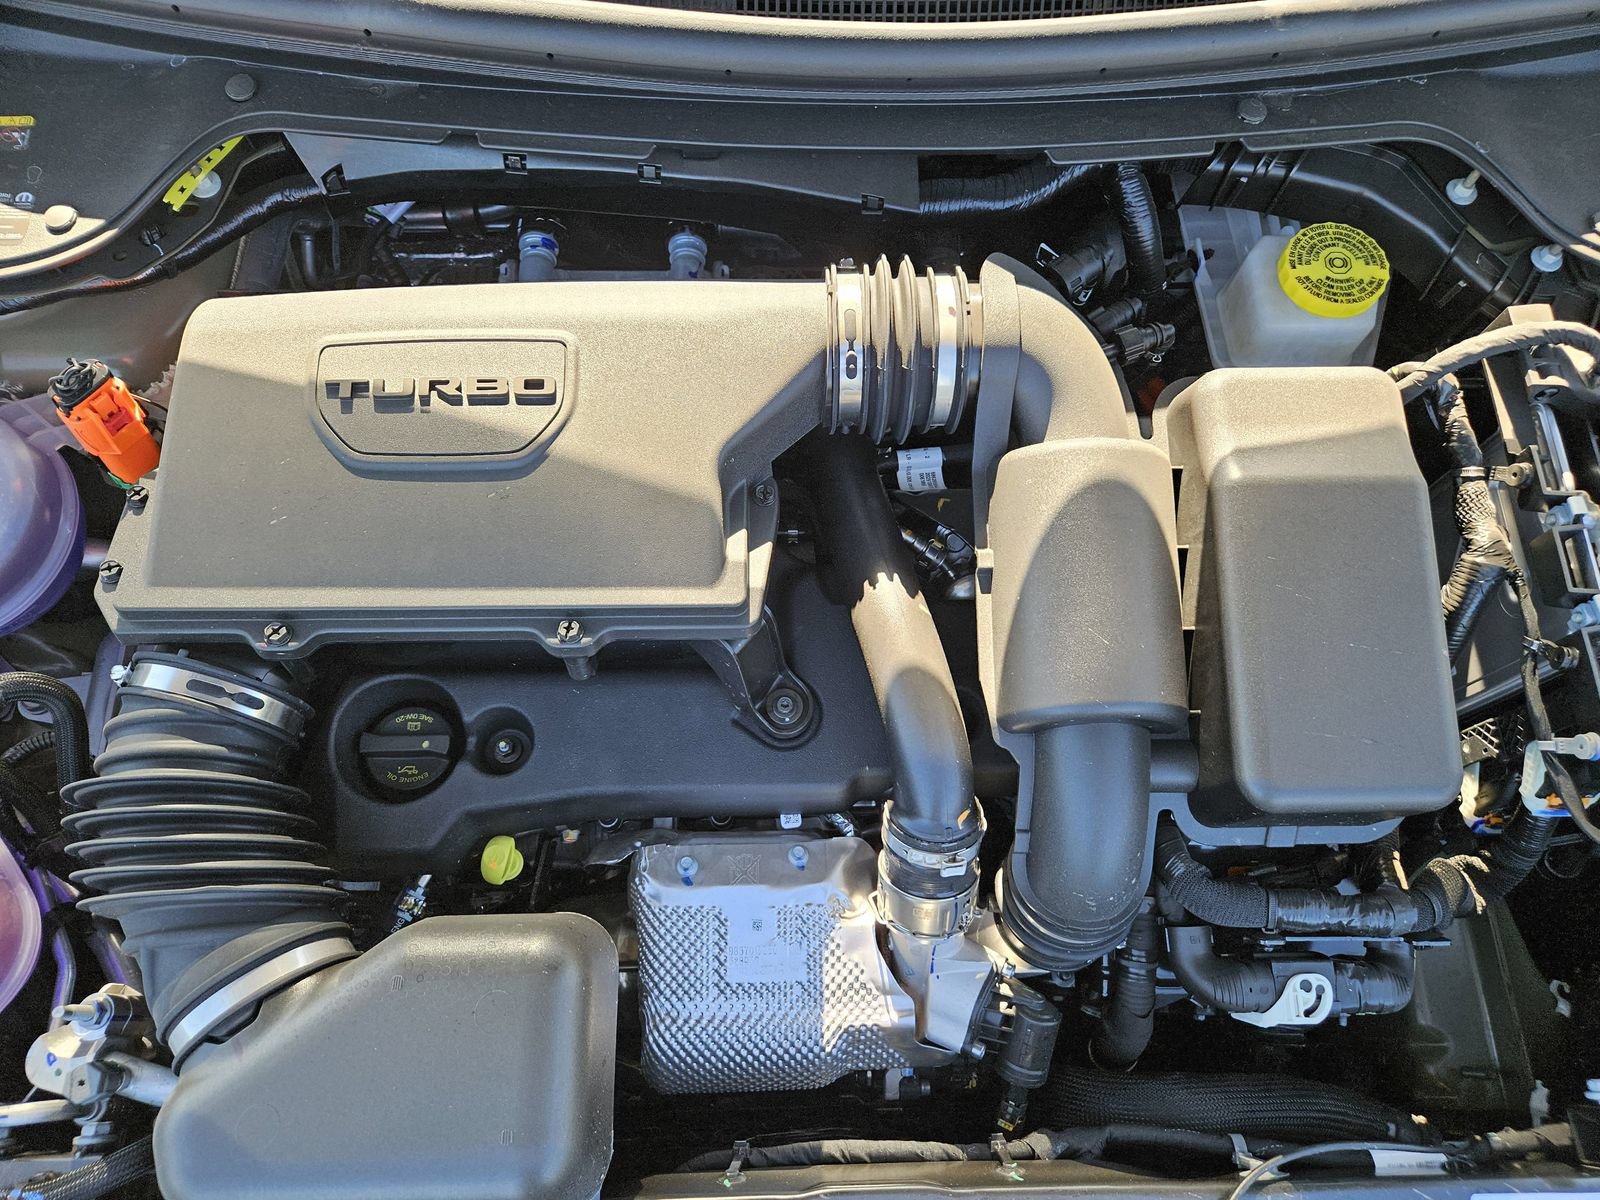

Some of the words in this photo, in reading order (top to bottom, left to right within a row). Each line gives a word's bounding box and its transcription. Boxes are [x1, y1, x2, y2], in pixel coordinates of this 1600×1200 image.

[1296, 276, 1306, 285] DOT
[325, 376, 557, 408] TURBO
[419, 713, 434, 723] SAE
[386, 771, 397, 781] OIL
[398, 771, 429, 783] ENGINE
